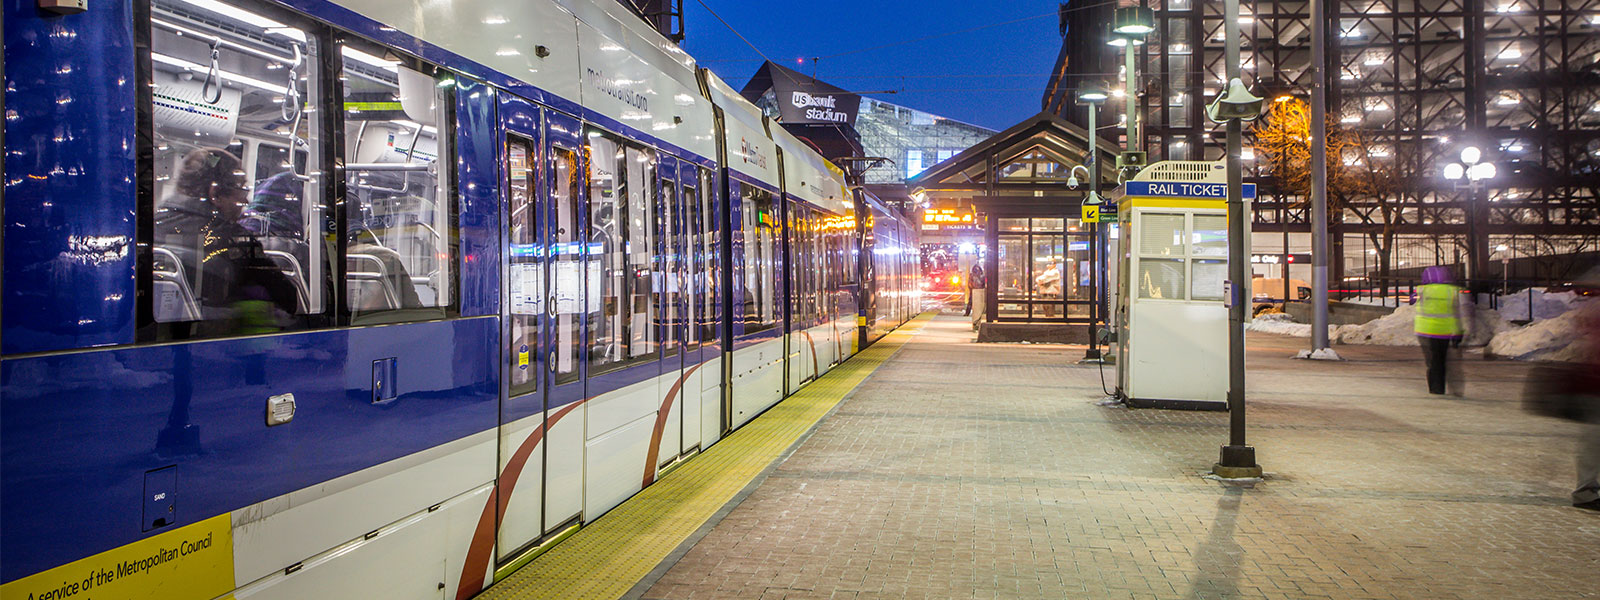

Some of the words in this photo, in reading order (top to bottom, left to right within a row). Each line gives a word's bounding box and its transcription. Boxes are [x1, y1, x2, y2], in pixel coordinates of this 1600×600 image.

[805, 107, 847, 122] stadium
[1148, 183, 1178, 195] RAIL
[1261, 254, 1279, 265] Only
[154, 492, 166, 502] SAND
[38, 581, 80, 600] service
[82, 570, 94, 591] of
[96, 568, 114, 586] the
[116, 548, 178, 580] Metropolitan
[180, 531, 213, 557] Council
